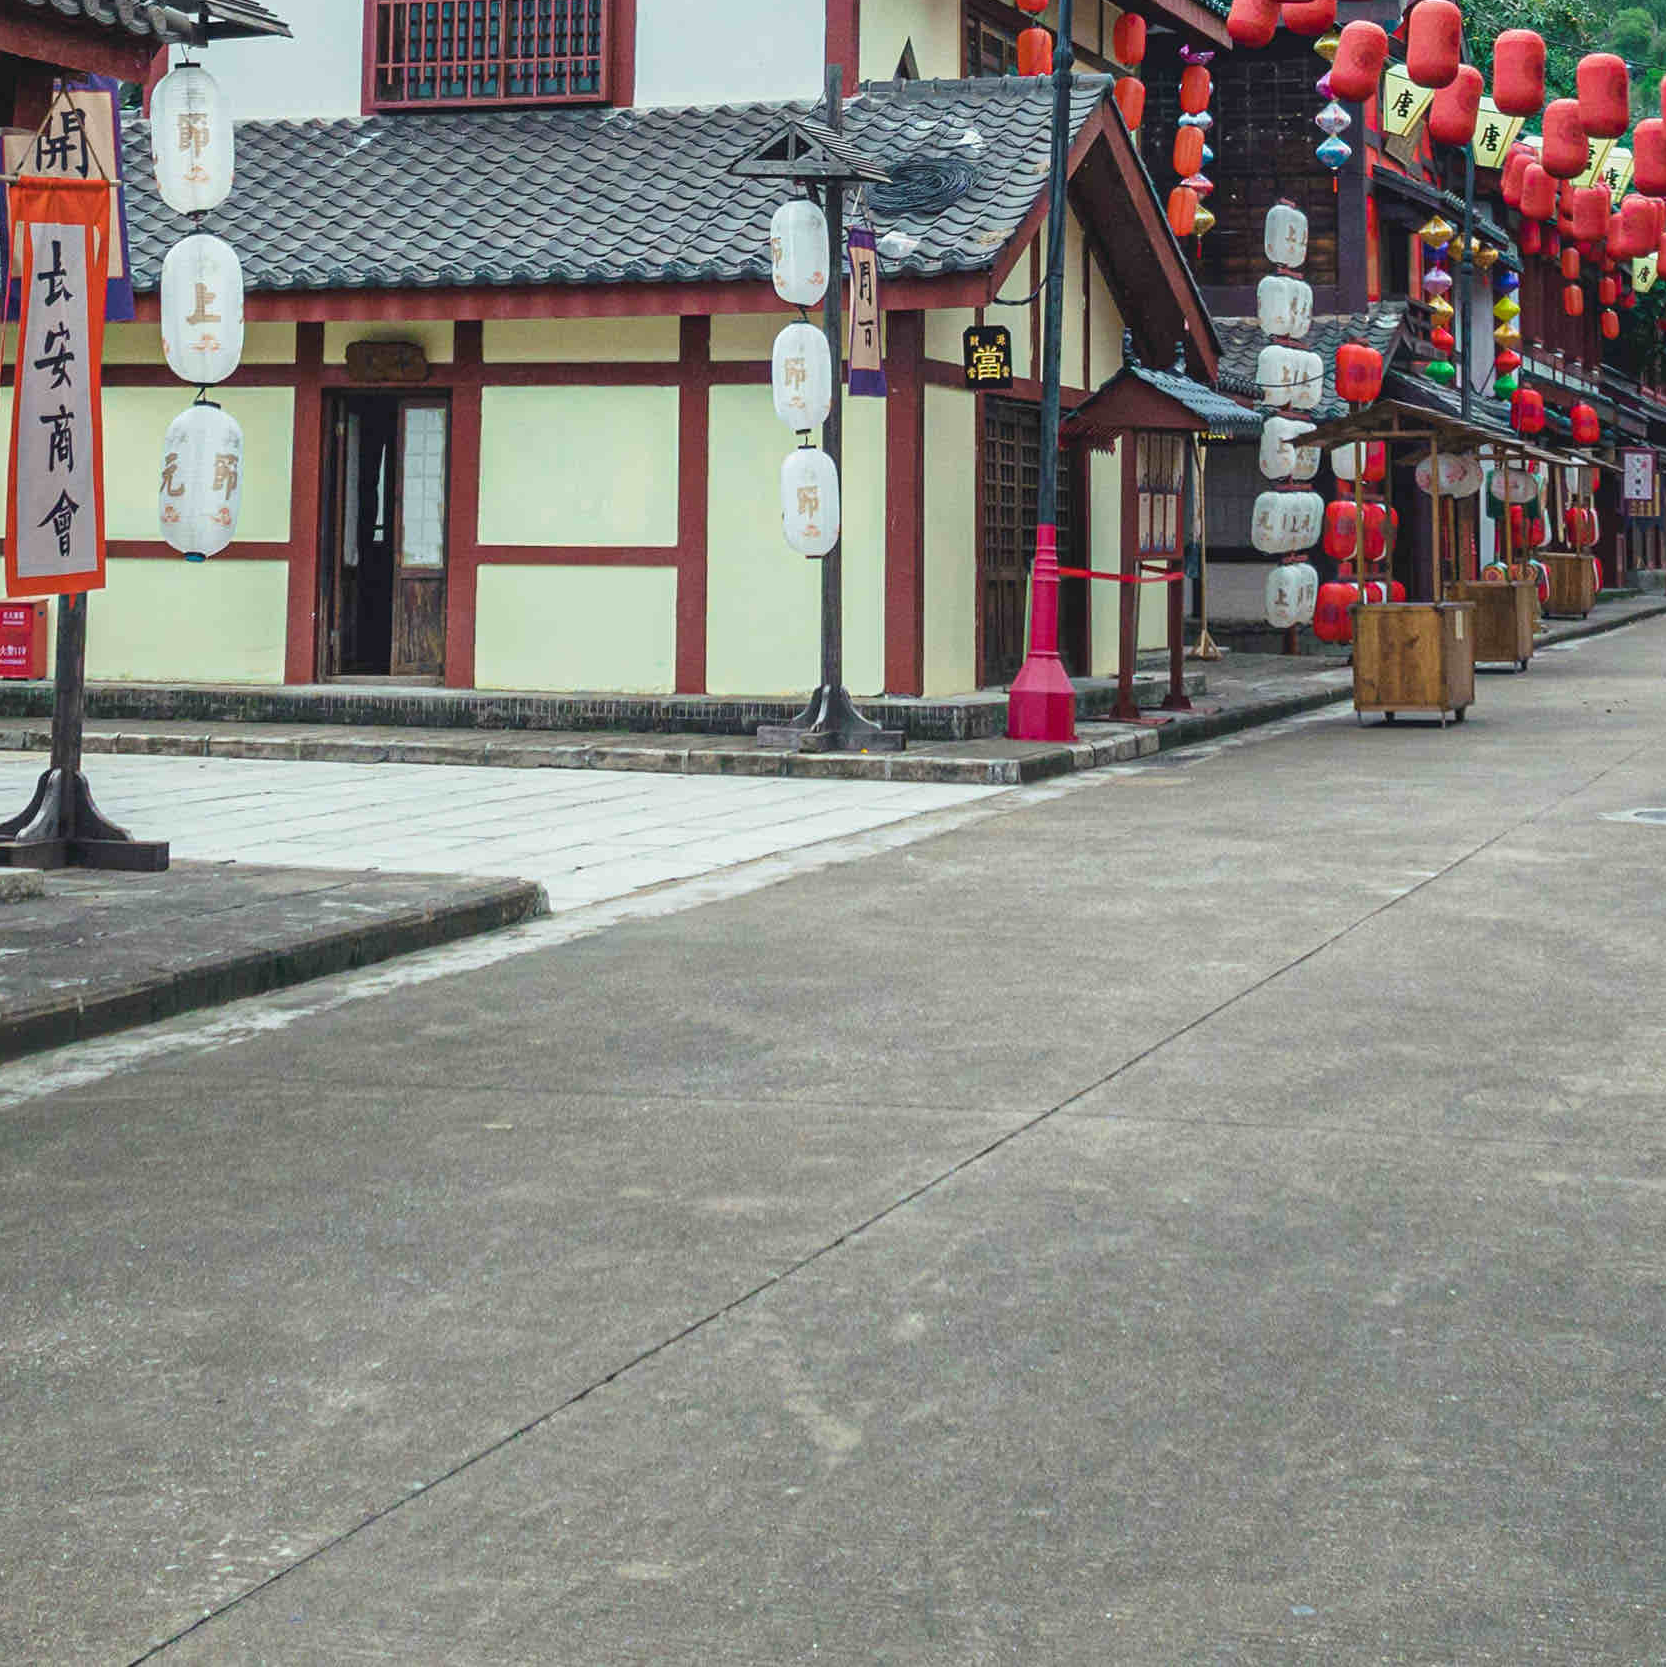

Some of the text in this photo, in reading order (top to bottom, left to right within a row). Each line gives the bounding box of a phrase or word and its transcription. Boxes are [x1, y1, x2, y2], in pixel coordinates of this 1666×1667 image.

[1392, 89, 1414, 118] 唐
[35, 108, 89, 179] 開
[1480, 123, 1501, 152] 唐
[186, 282, 222, 325] 上
[973, 344, 1003, 380] 當
